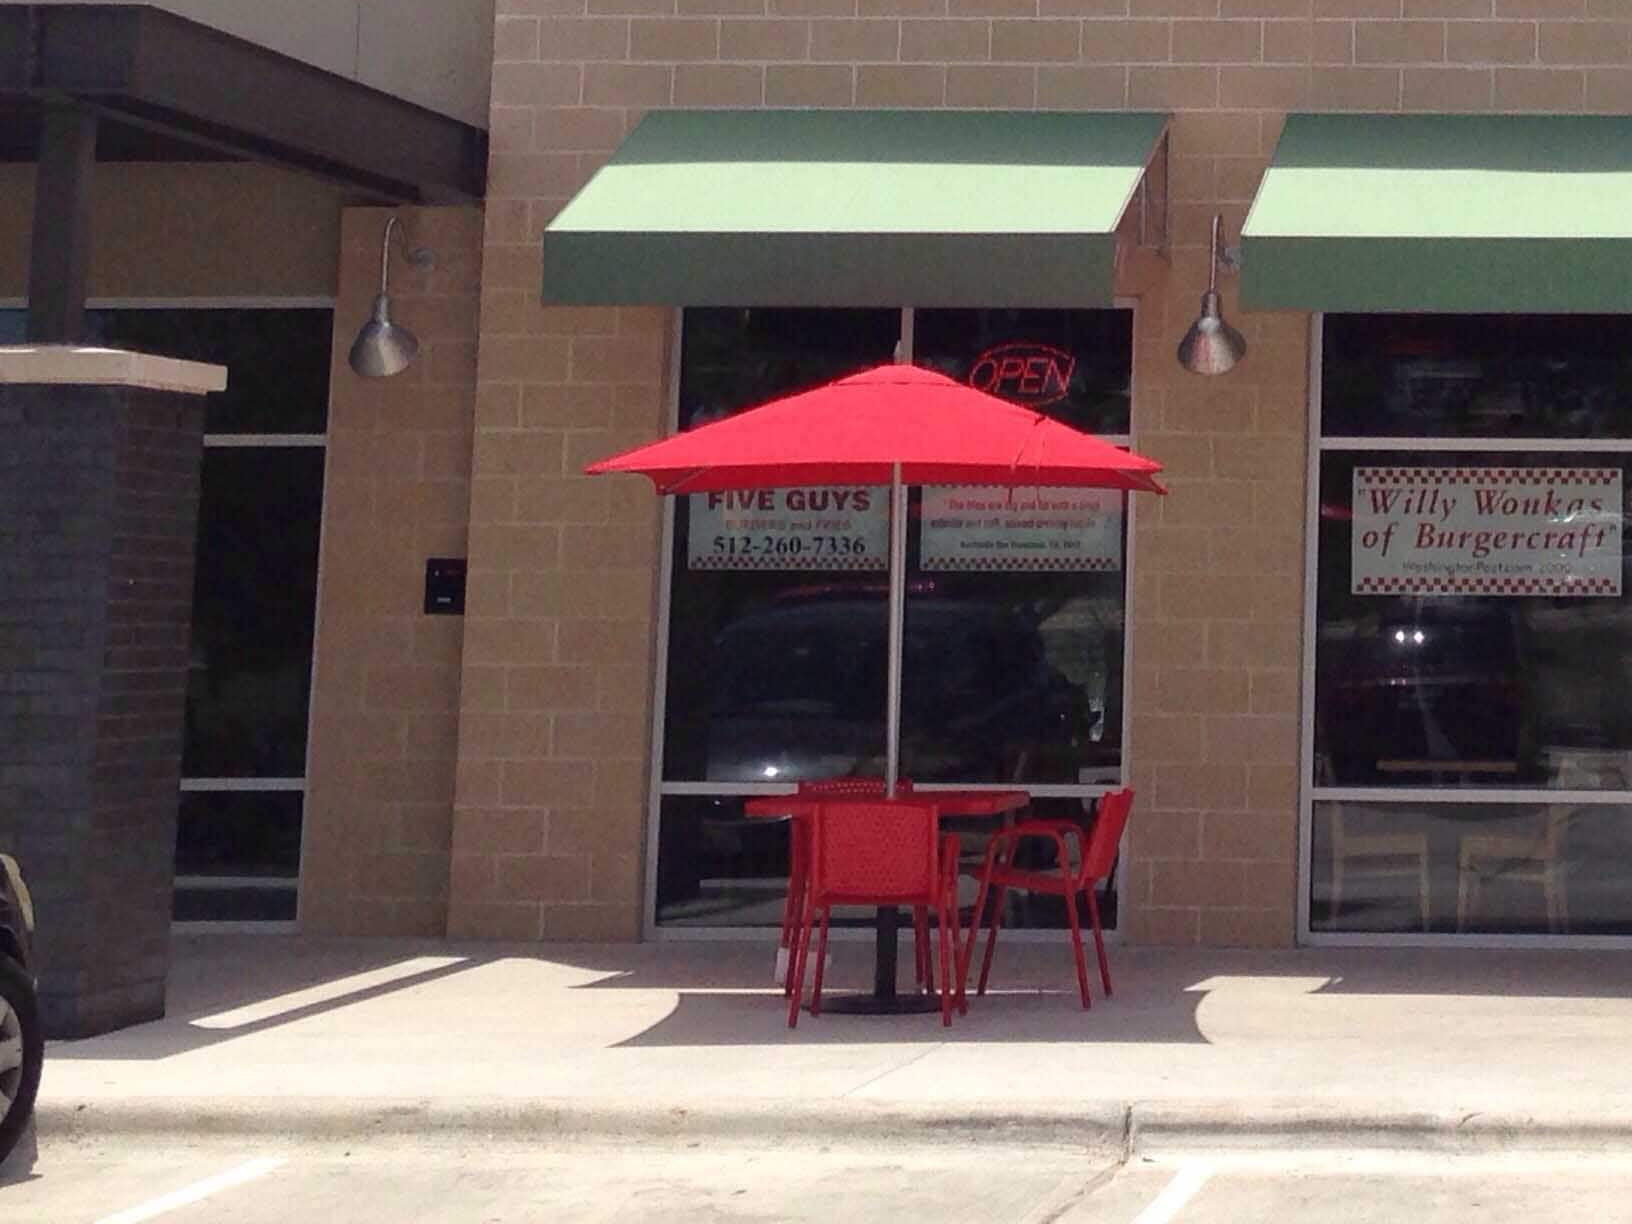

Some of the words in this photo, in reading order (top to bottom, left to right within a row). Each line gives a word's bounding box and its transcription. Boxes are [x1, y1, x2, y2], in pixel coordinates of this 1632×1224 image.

[969, 357, 1076, 393] OPEN
[707, 489, 775, 511] FIVE
[786, 489, 871, 511] GUYS
[713, 536, 866, 555] 512-260-7336
[1362, 522, 1398, 557] of
